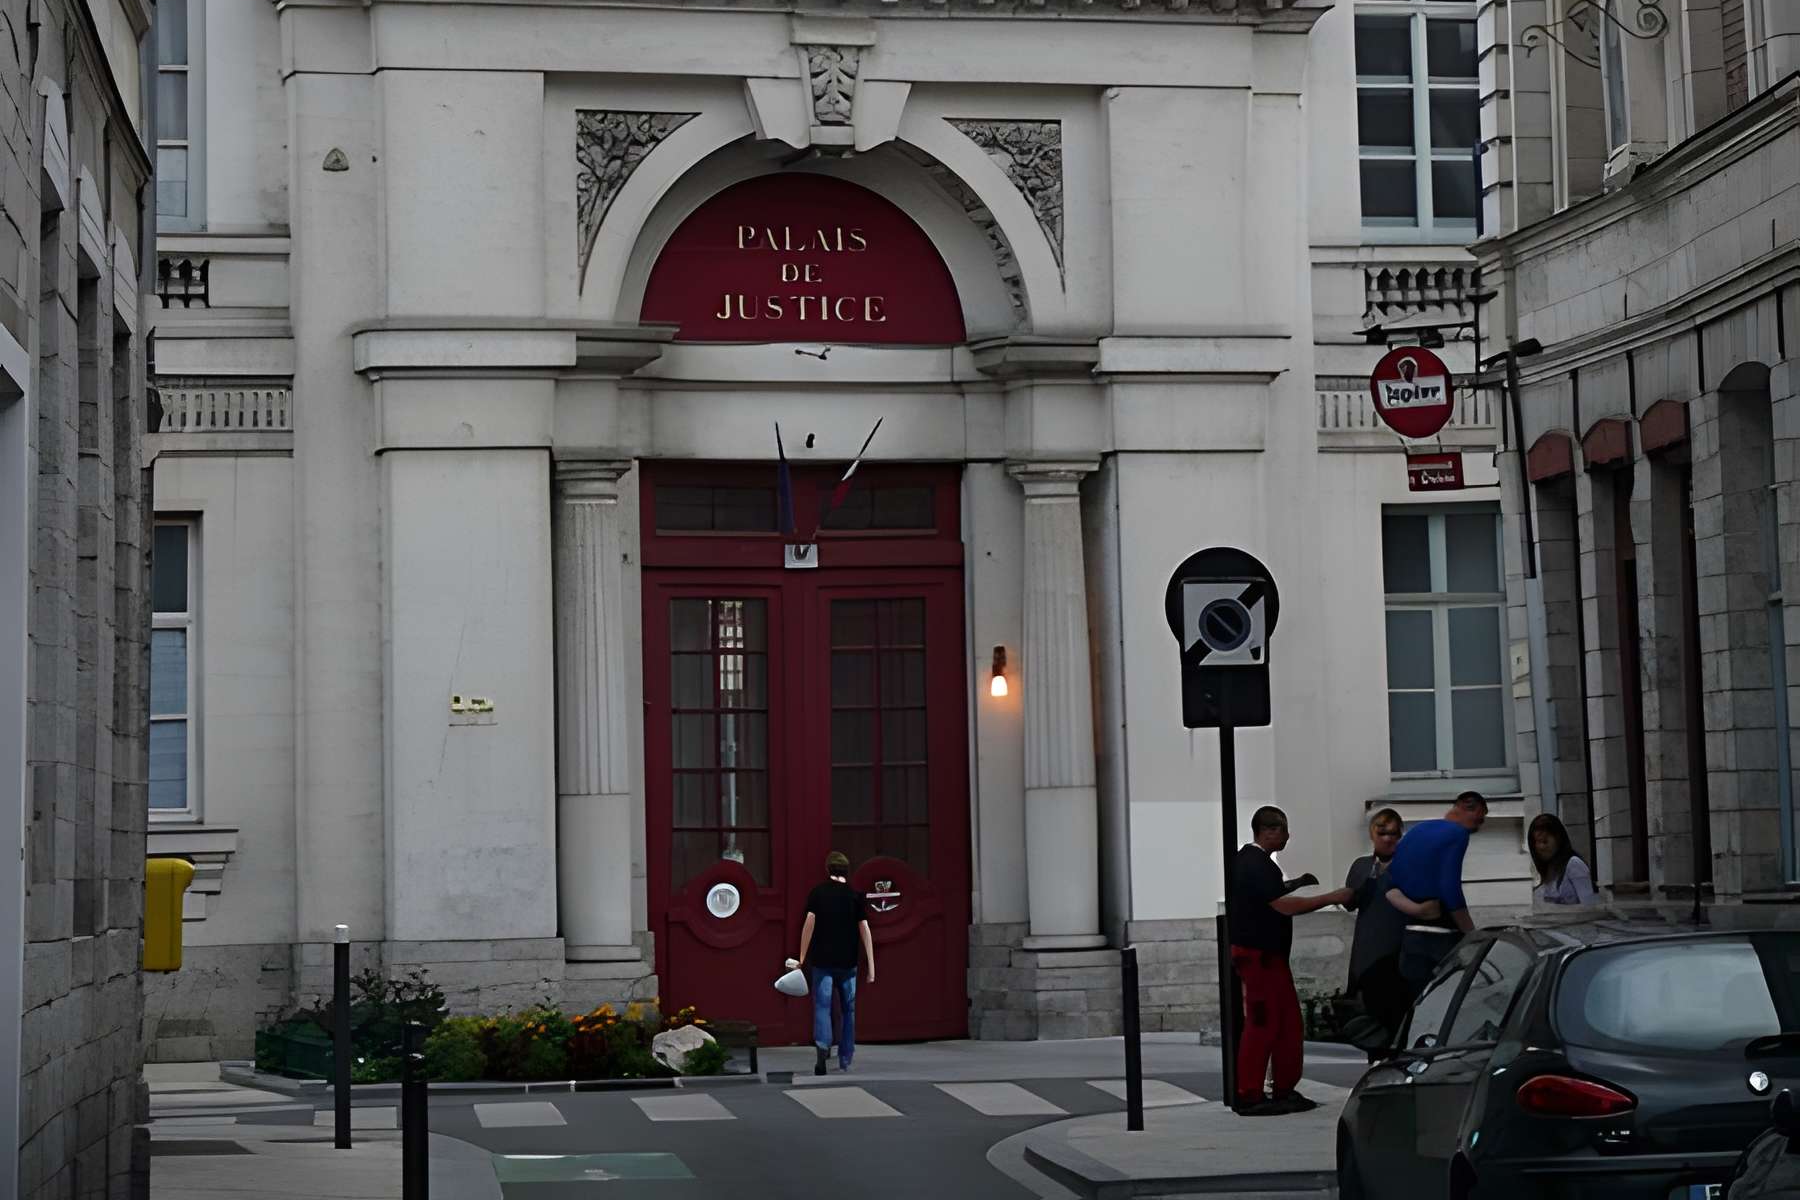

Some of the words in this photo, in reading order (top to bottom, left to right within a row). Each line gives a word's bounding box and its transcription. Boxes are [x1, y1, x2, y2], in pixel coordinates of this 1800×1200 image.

[738, 225, 867, 251] PALAIS
[782, 263, 822, 282] DE
[716, 294, 886, 322] JUSTICE
